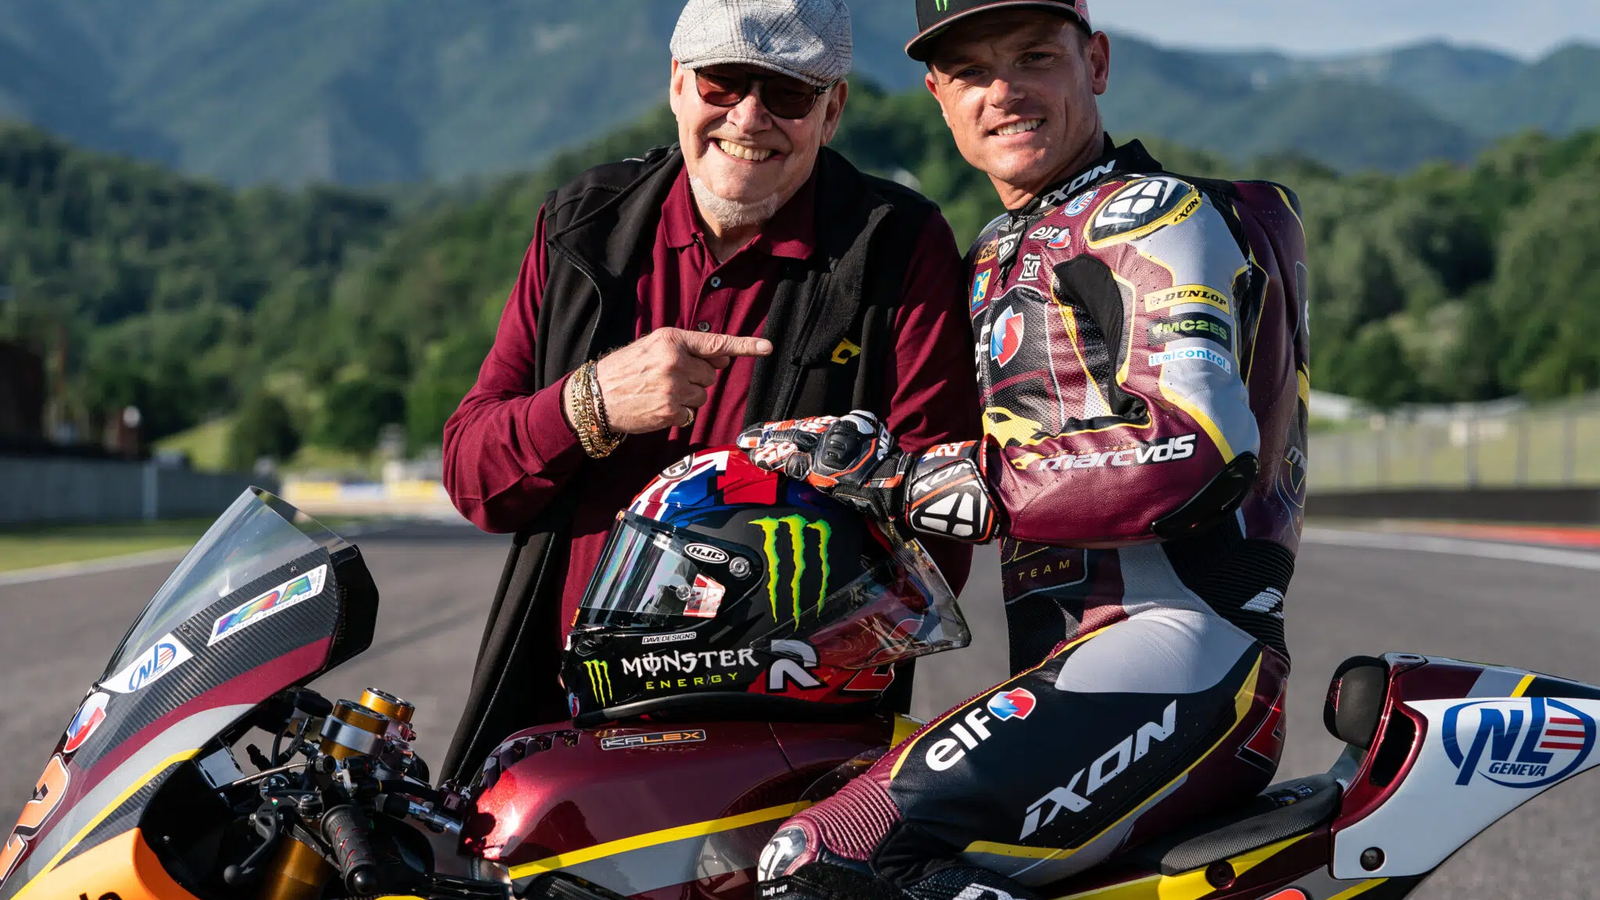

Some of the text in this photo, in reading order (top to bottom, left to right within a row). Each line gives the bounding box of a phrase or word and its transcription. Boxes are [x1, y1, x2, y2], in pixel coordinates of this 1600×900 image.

[1163, 290, 1227, 306] DUNLOP
[690, 546, 723, 560] HJC
[1018, 559, 1070, 581] TEAM
[620, 648, 759, 678] MONSTER
[645, 672, 738, 690] ENERGY
[605, 731, 701, 748] KALEX
[924, 706, 992, 772] elf
[1488, 762, 1547, 777] GENEVA
